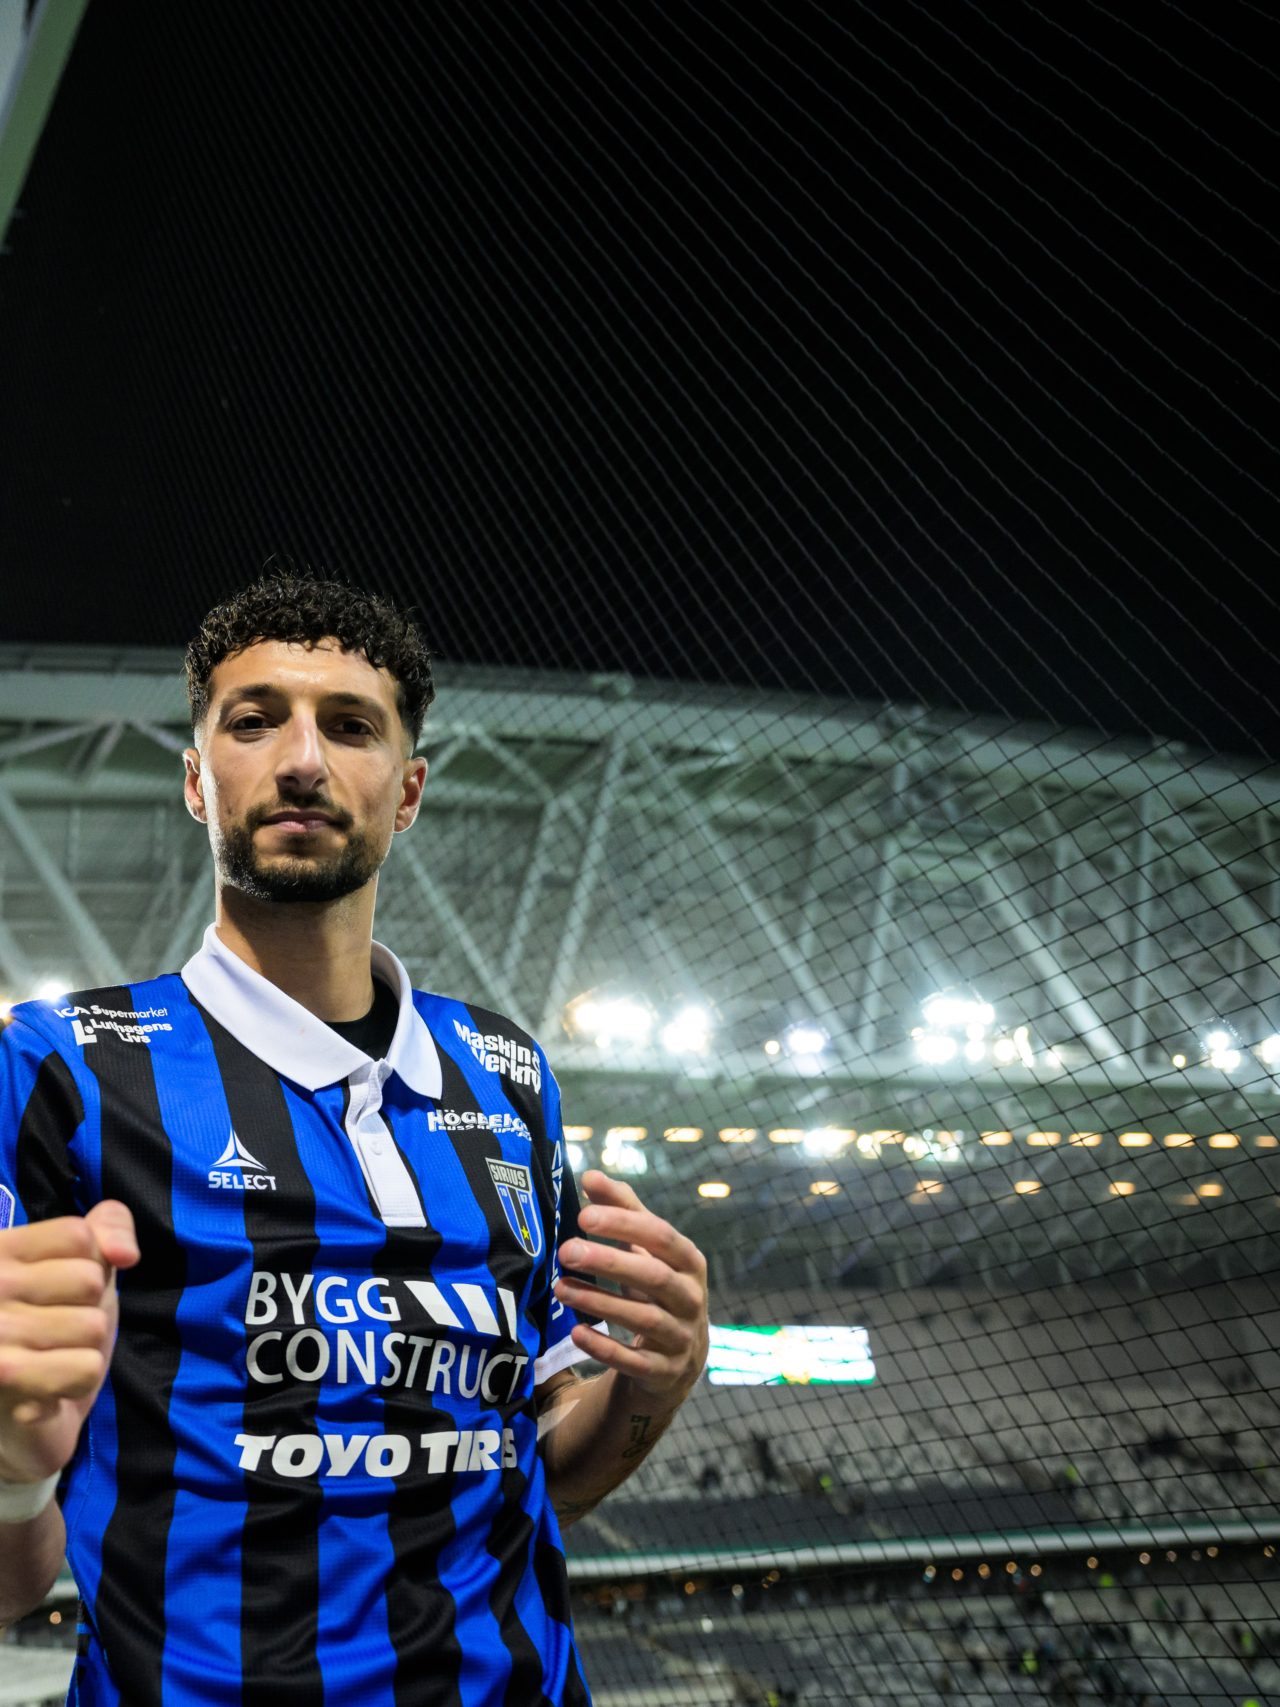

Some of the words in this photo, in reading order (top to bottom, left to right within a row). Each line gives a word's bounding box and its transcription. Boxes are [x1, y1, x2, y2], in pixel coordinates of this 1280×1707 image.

[90, 1004, 168, 1019] Supermarket
[453, 1019, 531, 1065] Maskin
[208, 1171, 277, 1191] SELECT
[490, 1164, 527, 1188] SIRIUS
[245, 1271, 402, 1325] BYGG
[246, 1328, 529, 1404] CONSTRUCT
[233, 1434, 412, 1478] TOYO
